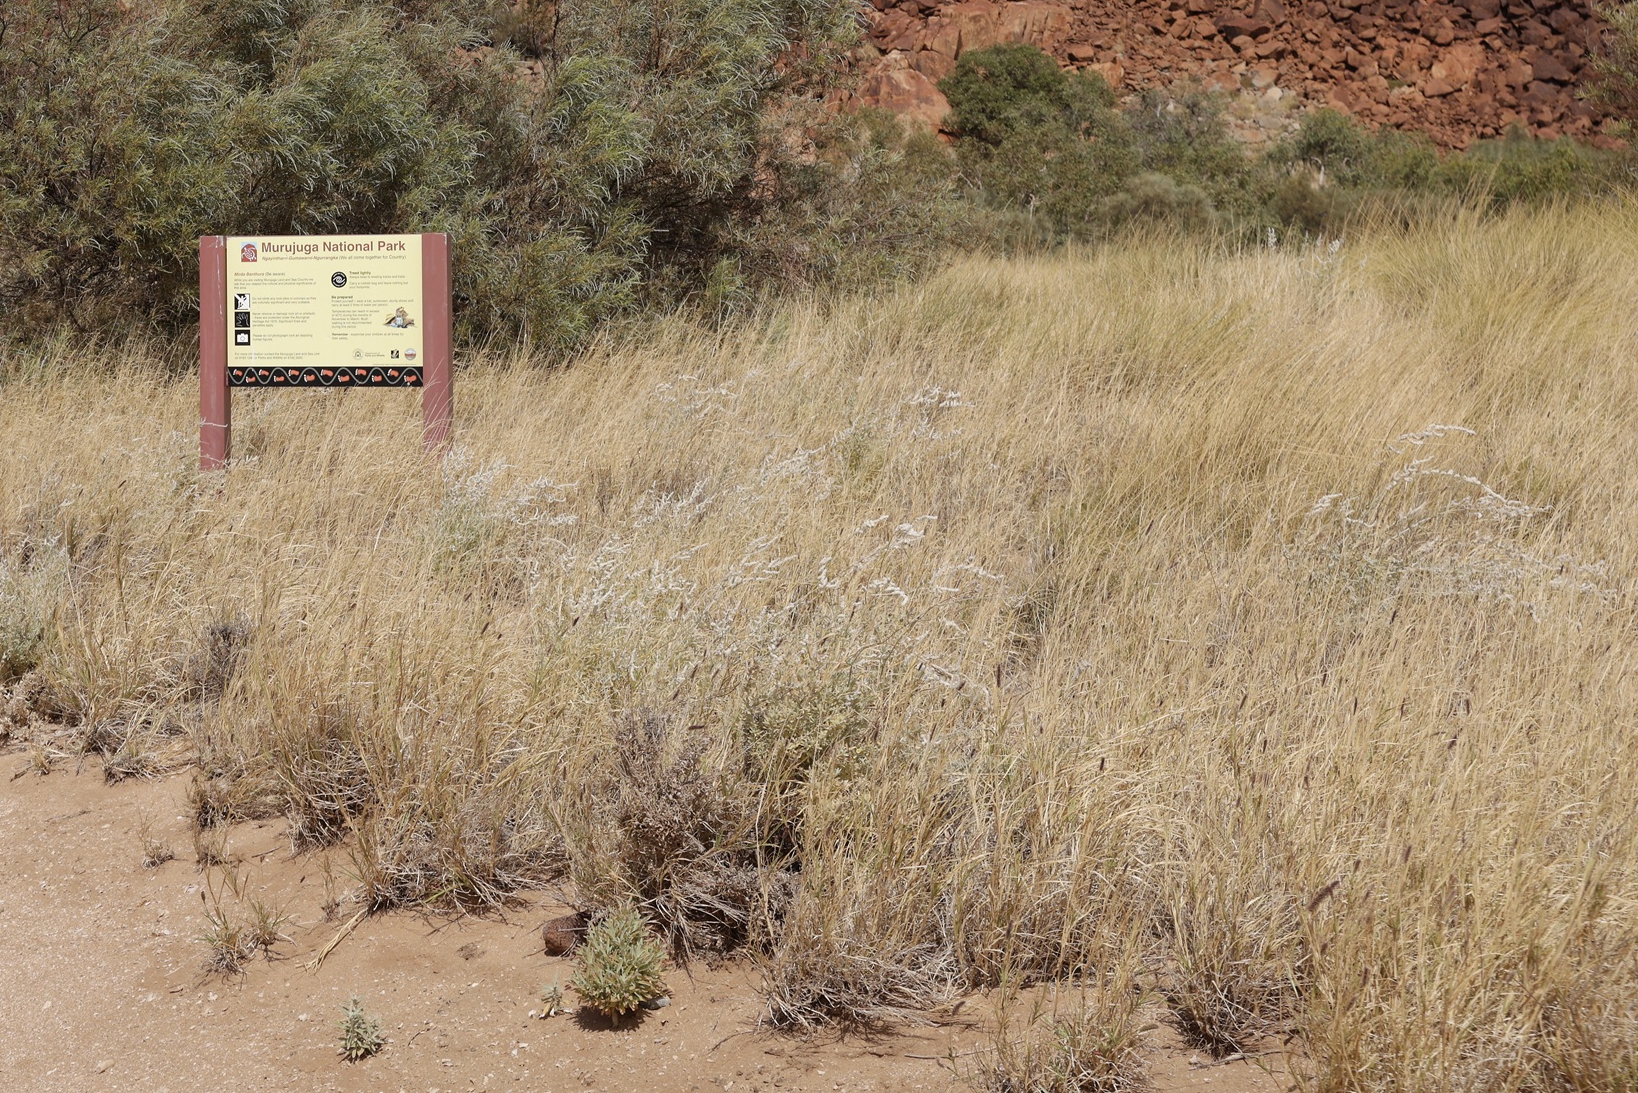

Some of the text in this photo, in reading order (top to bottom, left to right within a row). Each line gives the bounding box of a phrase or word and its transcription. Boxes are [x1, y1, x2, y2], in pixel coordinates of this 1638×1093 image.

[261, 241, 406, 255] Murujuga National Park
